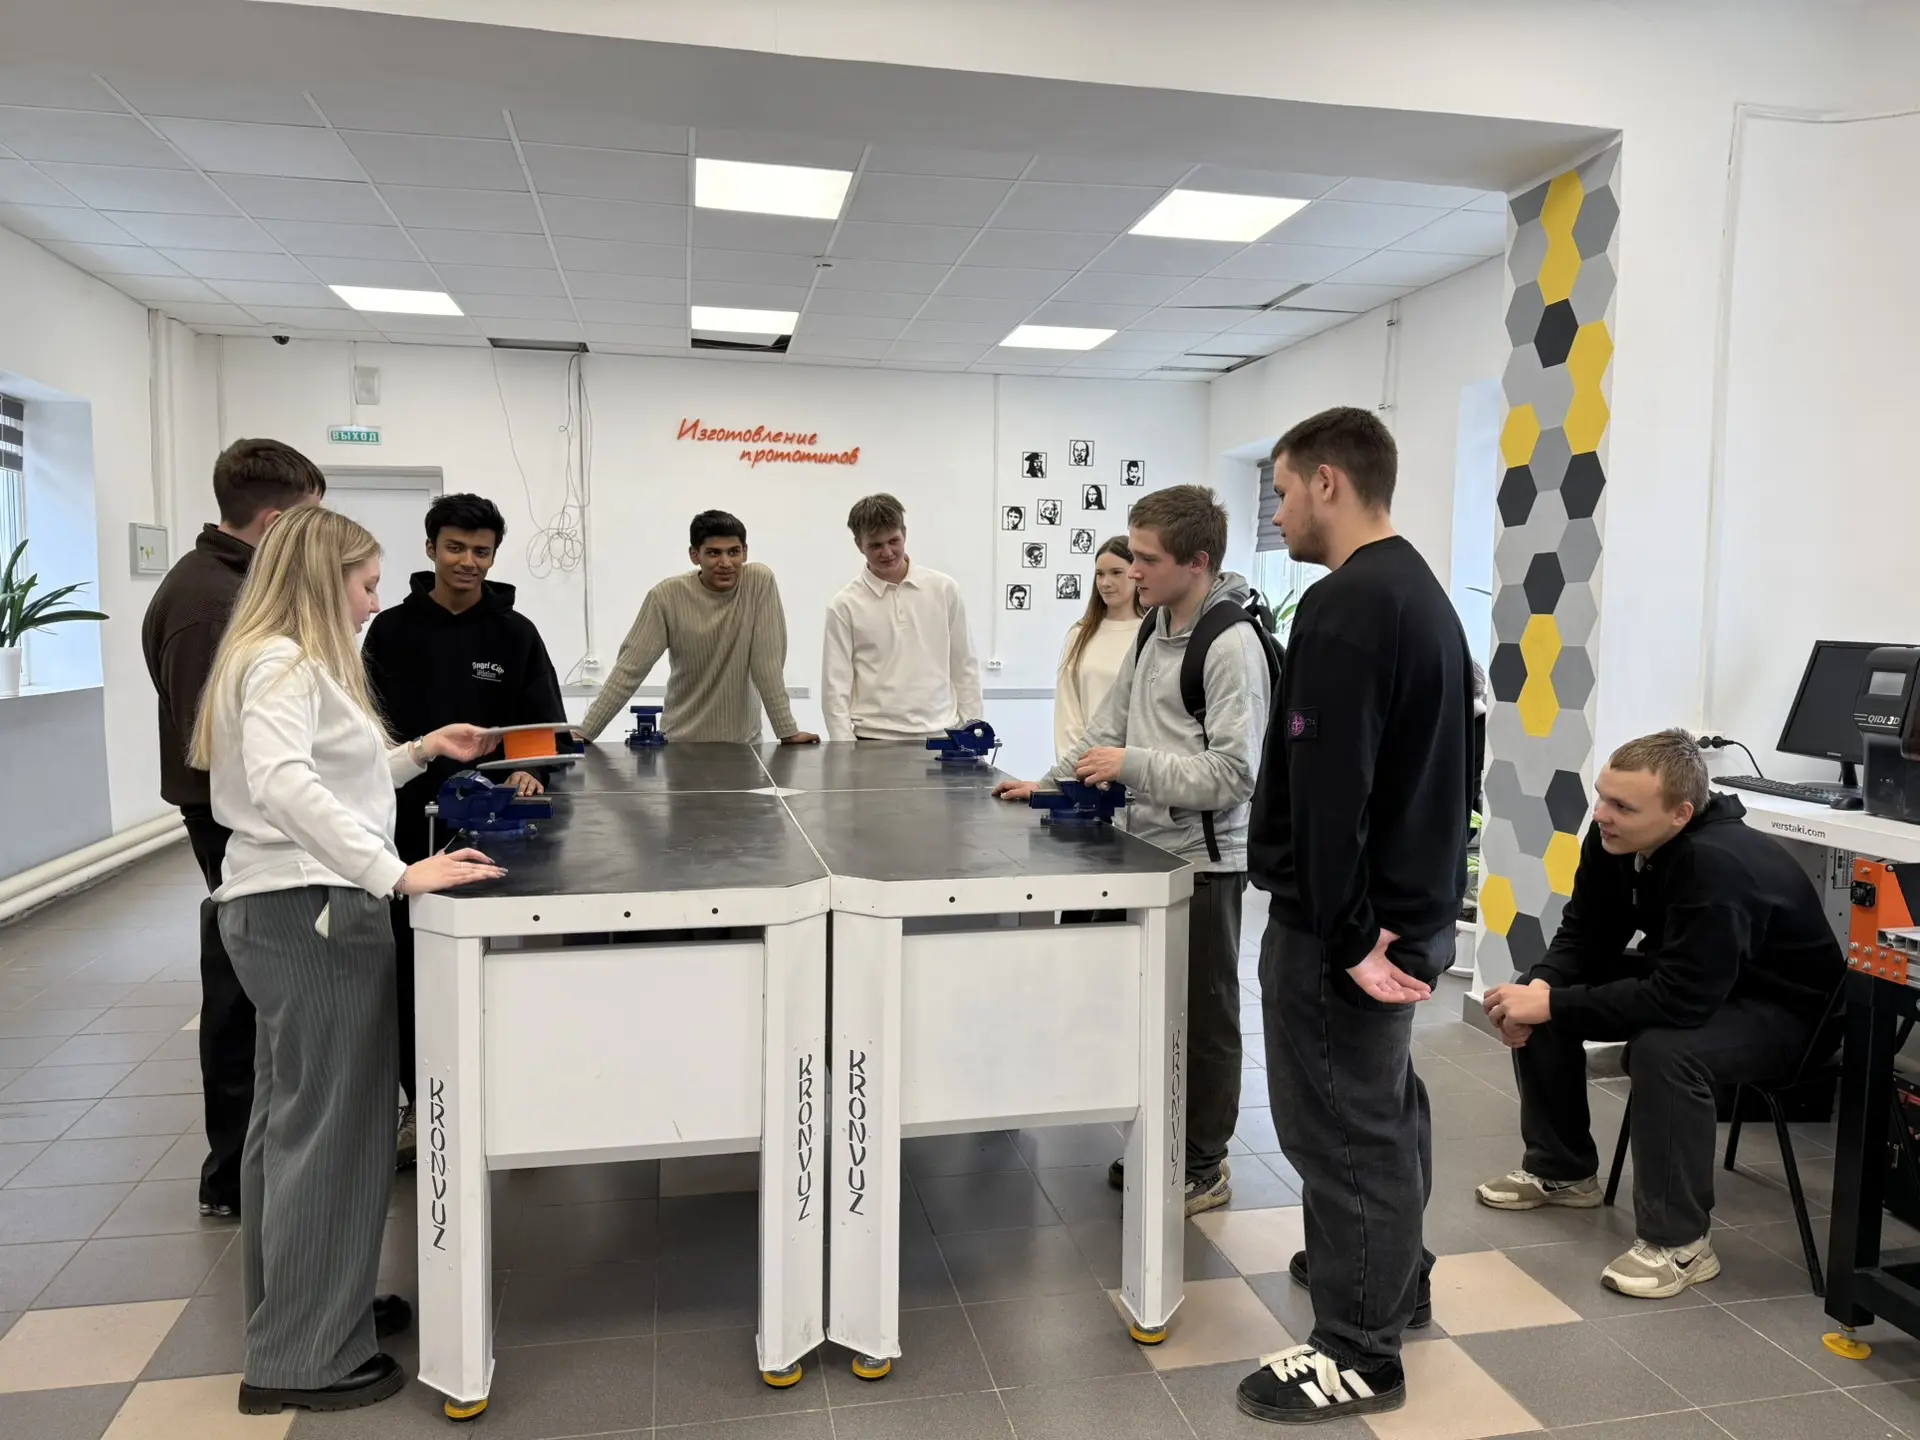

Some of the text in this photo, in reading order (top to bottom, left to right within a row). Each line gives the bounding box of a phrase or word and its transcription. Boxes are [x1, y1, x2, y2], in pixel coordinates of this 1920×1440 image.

[332, 431, 377, 442] ВЫХОД
[676, 417, 819, 446] Изготовление
[739, 446, 861, 468] прототипов
[1868, 714, 1901, 725] QIDI 3D
[1771, 820, 1826, 839] verstaki.com
[1171, 1029, 1181, 1186] KRONVUZ
[797, 1053, 813, 1222] KRONVUZ
[848, 1049, 866, 1216] KRONVUZ
[429, 1077, 446, 1251] KRONVUZ
